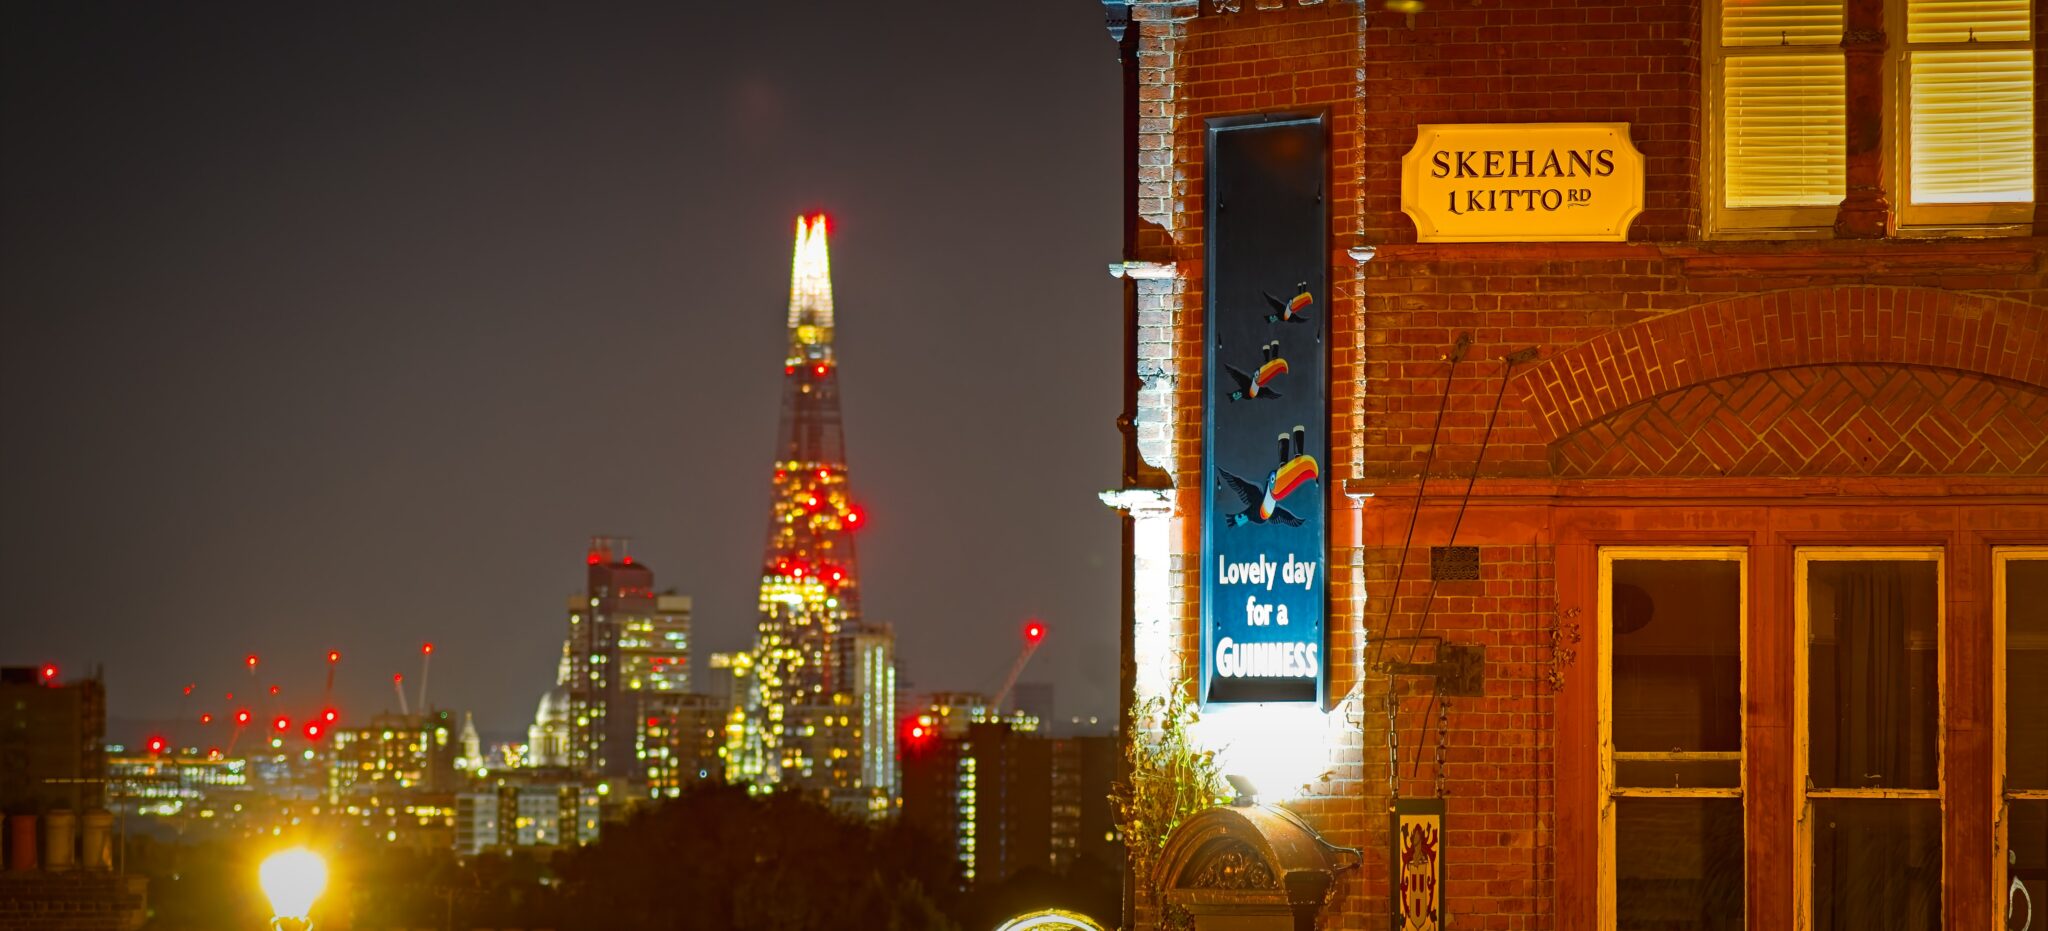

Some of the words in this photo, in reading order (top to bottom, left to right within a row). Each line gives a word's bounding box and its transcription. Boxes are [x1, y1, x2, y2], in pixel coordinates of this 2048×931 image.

[1431, 148, 1615, 179] SKEHANS
[1466, 188, 1563, 212] KITTO
[1567, 188, 1592, 203] RD
[1219, 553, 1278, 591] Lovely
[1282, 553, 1316, 590] day
[1246, 595, 1273, 626] for
[1276, 603, 1289, 626] a
[1216, 636, 1319, 678] GUINNESS
